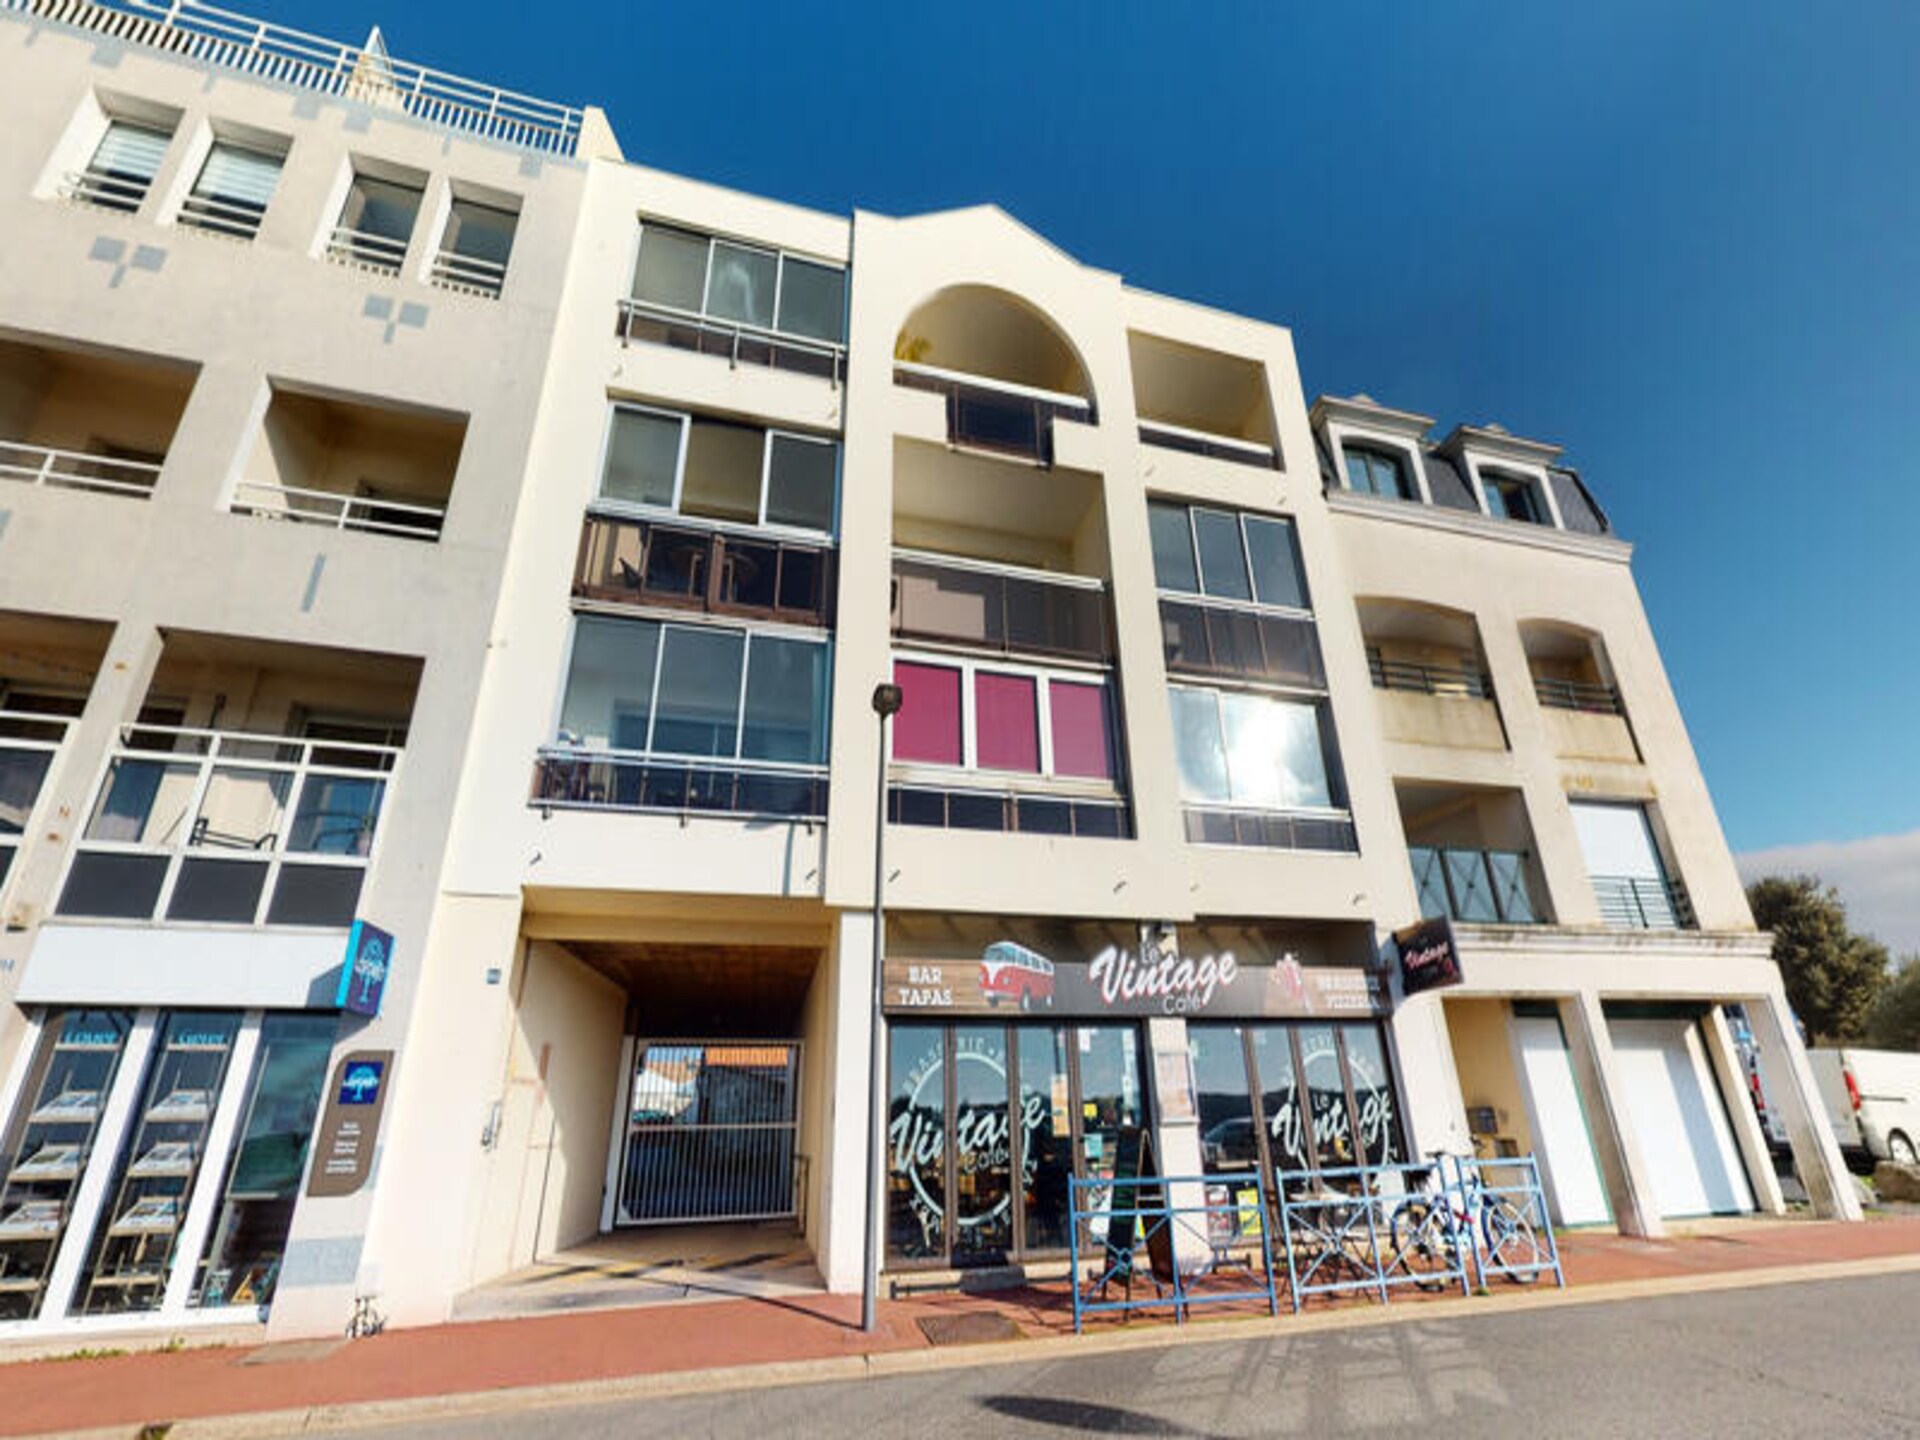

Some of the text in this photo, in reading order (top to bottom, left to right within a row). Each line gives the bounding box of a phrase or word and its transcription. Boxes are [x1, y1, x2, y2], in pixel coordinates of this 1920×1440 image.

[908, 965, 942, 985] BAR
[1088, 945, 1238, 1007] Vintage
[900, 988, 953, 1006] TAPAS
[889, 1095, 1046, 1173] Vintae
